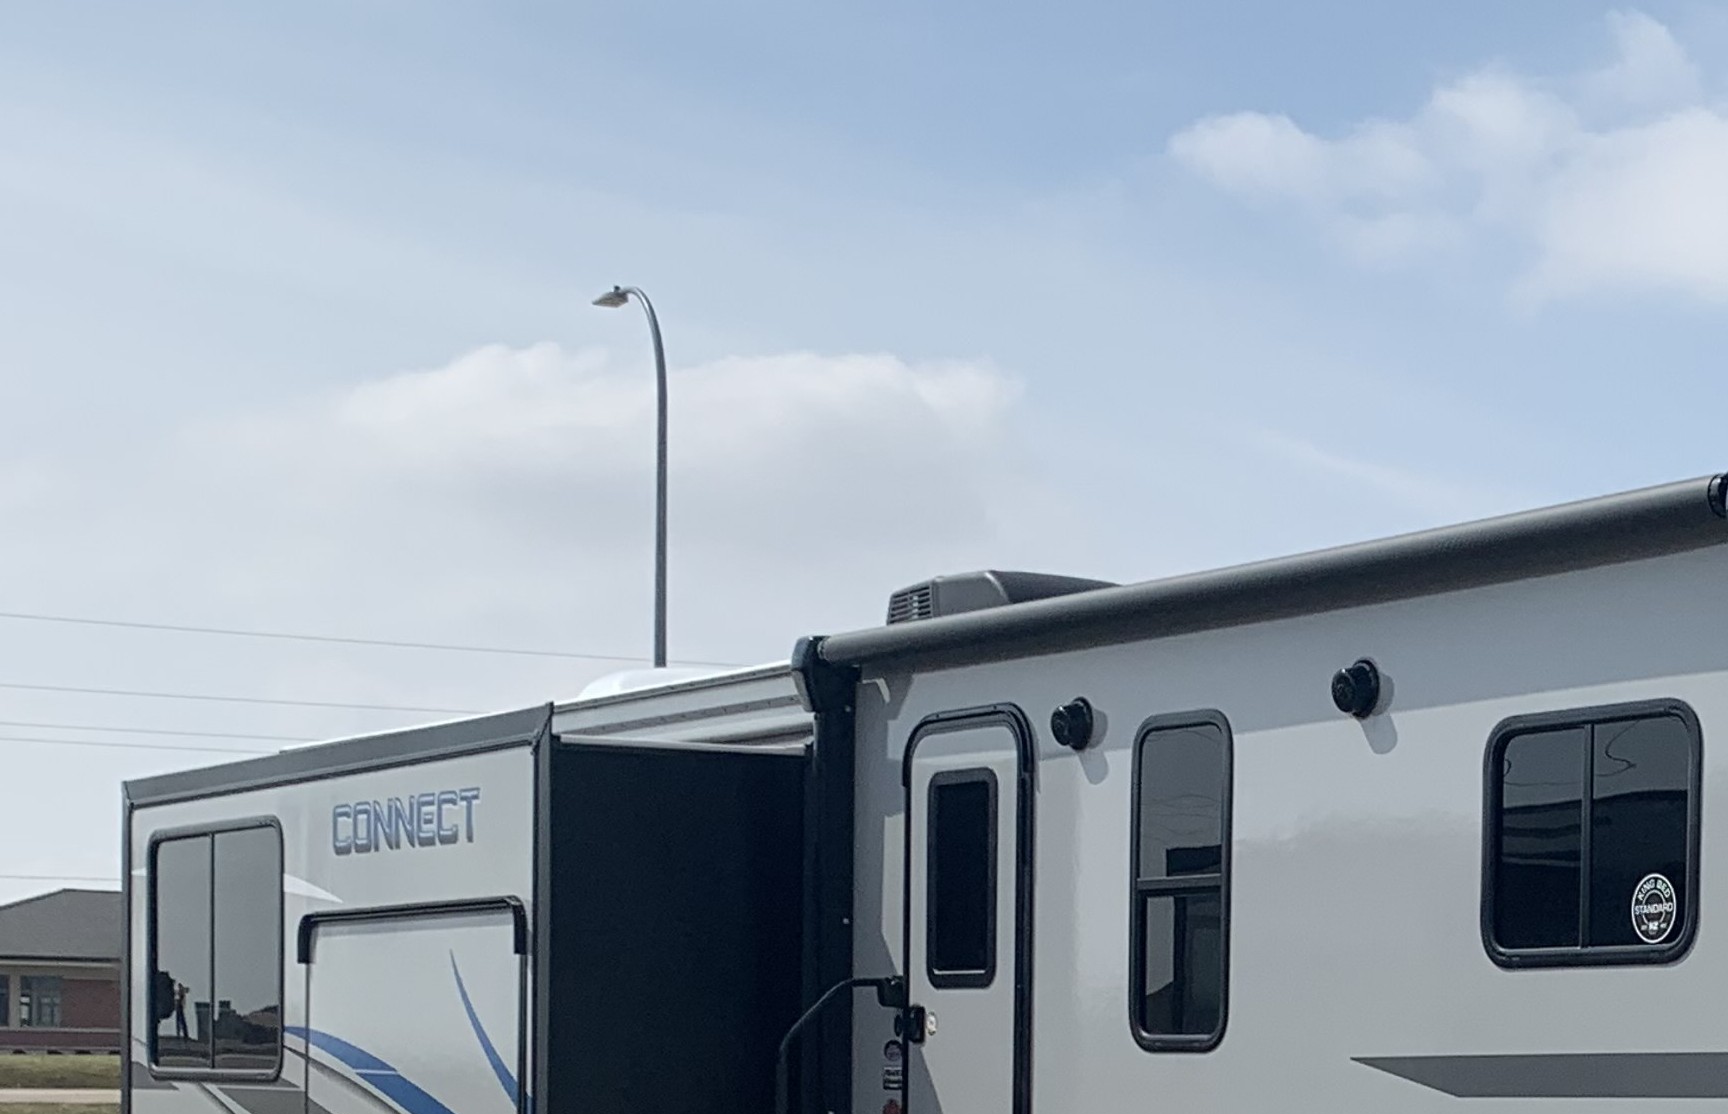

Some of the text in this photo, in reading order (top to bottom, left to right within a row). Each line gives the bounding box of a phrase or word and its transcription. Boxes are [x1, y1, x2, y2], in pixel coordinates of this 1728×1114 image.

[332, 787, 481, 856] CONNECT
[1638, 879, 1671, 900] KING BED
[1635, 903, 1673, 915] STANDARD
